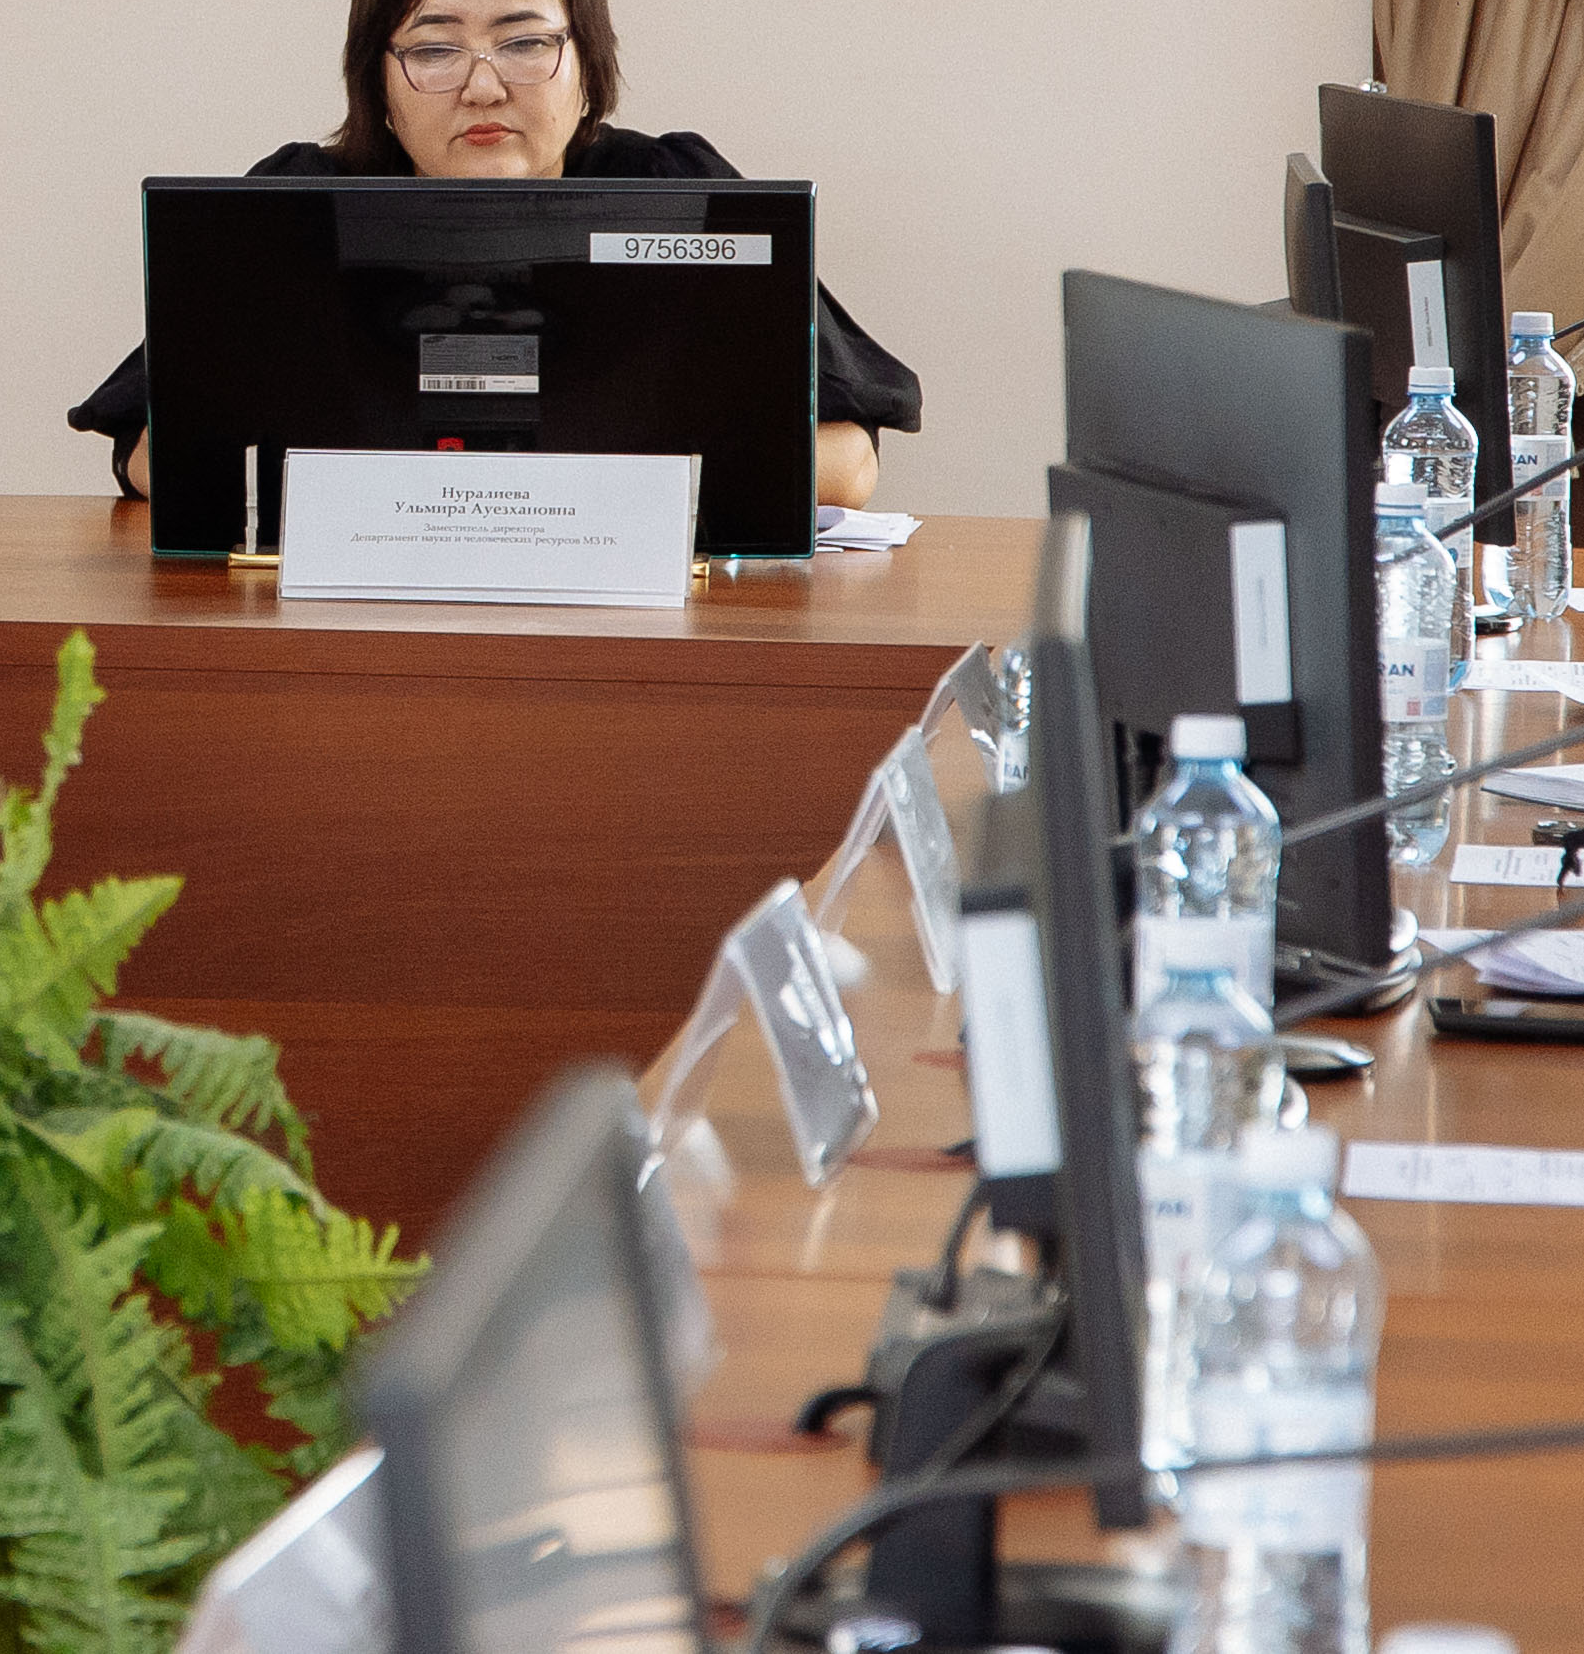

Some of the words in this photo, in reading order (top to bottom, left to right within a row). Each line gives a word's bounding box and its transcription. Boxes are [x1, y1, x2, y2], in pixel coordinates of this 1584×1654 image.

[624, 237, 737, 261] 9756396
[441, 486, 530, 502] Нуралиева
[394, 501, 466, 517] Ульмира
[471, 502, 576, 518] Ауезхановна
[423, 522, 488, 533] Заместитель
[491, 525, 545, 536] директора
[421, 535, 452, 545] науки
[535, 536, 581, 547] ресурсов
